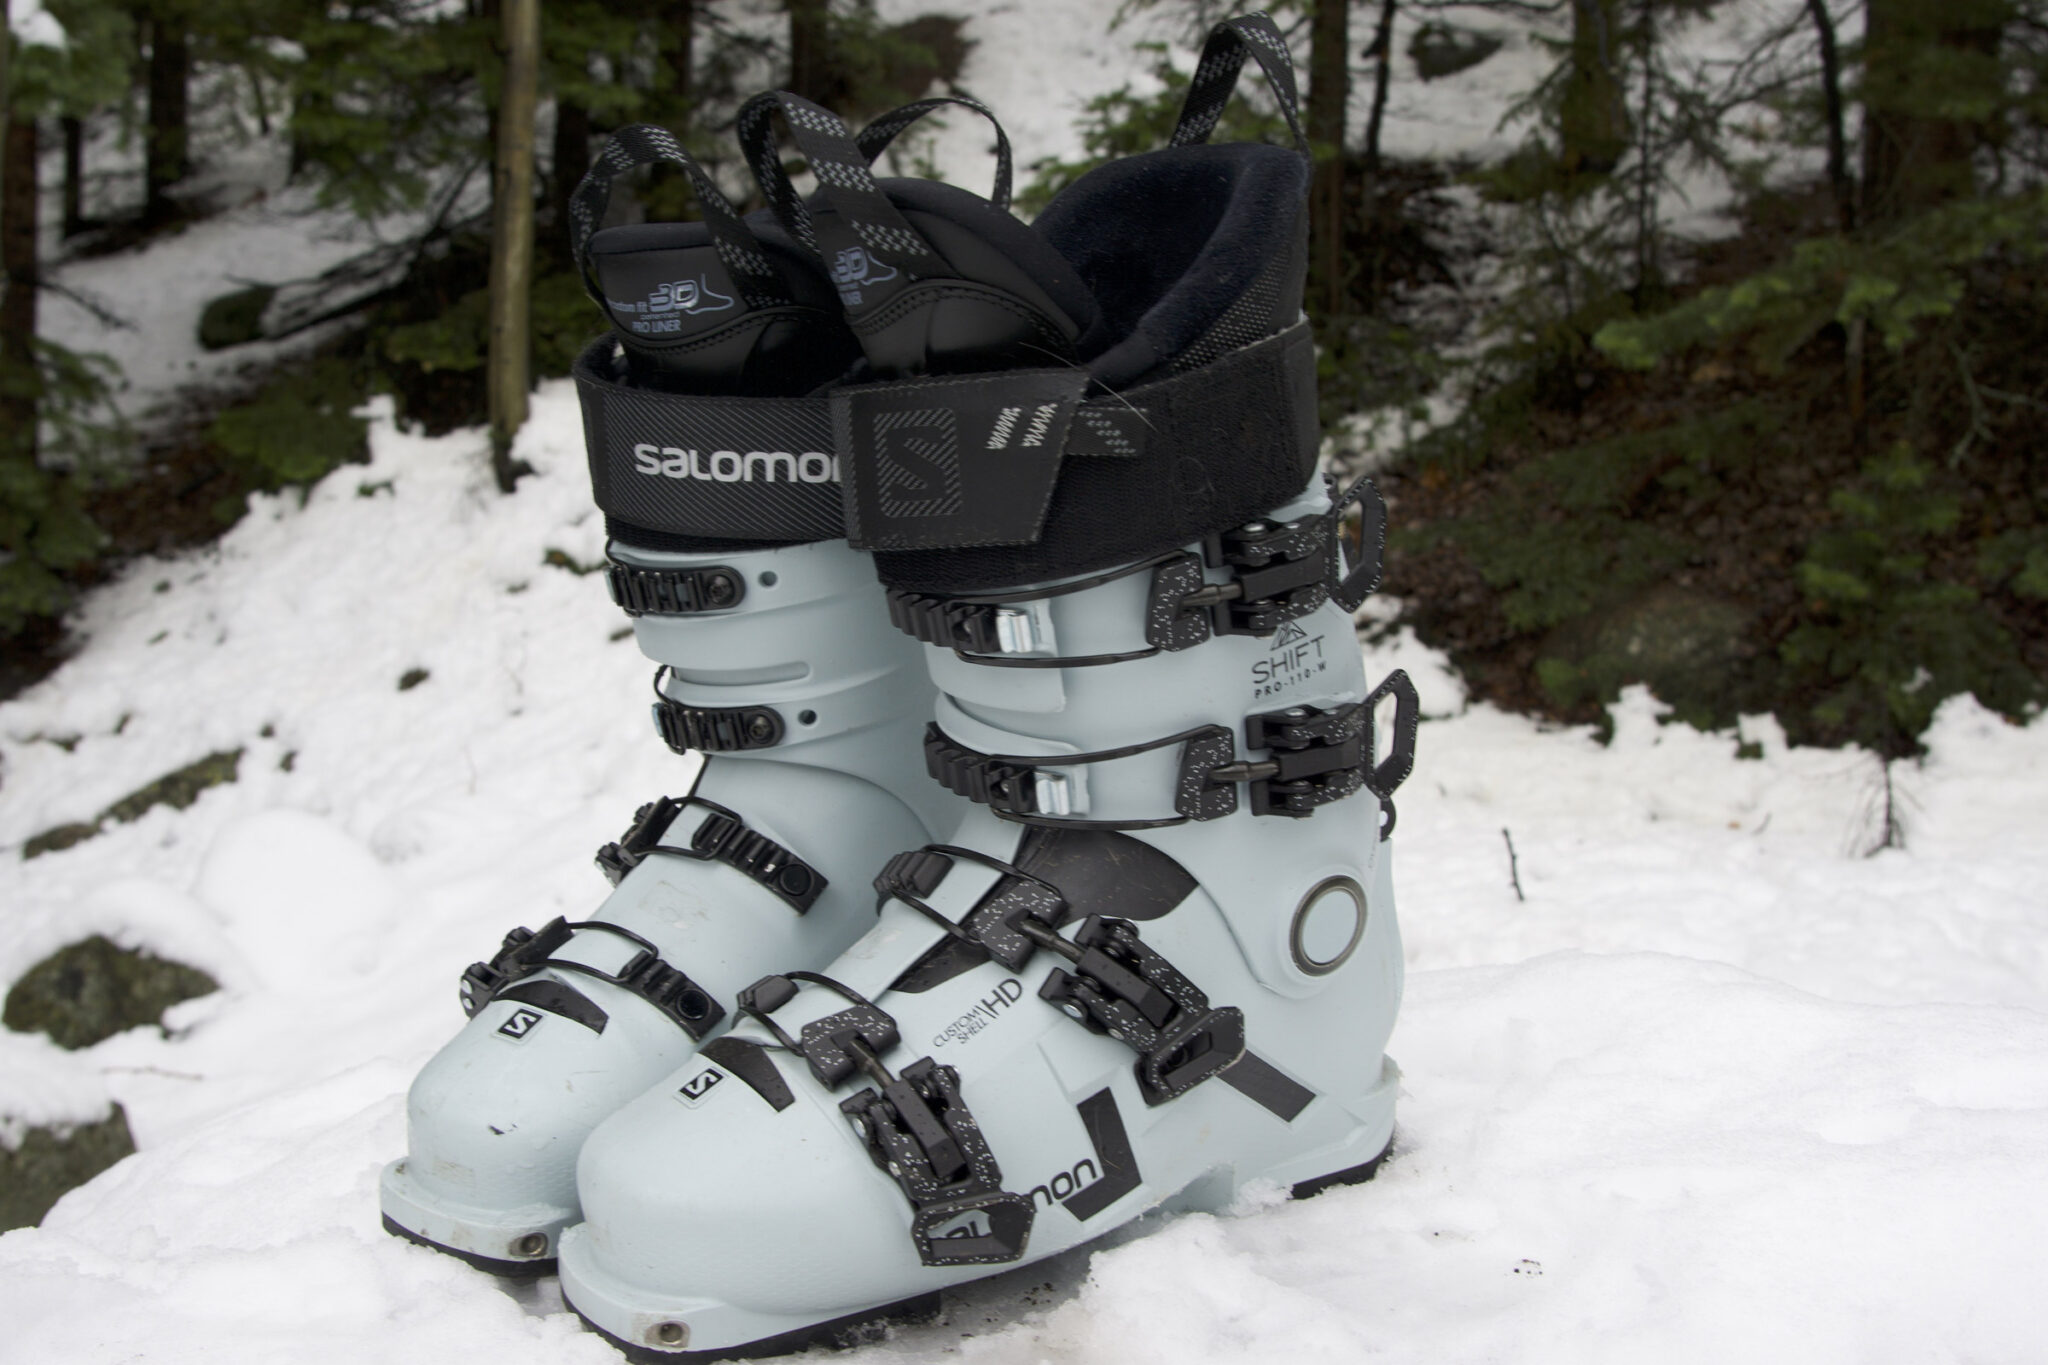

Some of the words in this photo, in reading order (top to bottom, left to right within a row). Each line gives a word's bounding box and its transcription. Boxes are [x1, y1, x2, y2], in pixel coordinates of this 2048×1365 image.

[1252, 635, 1325, 684] SHIFT
[932, 1008, 981, 1048] CUSTOM
[957, 1018, 989, 1045] SHELL
